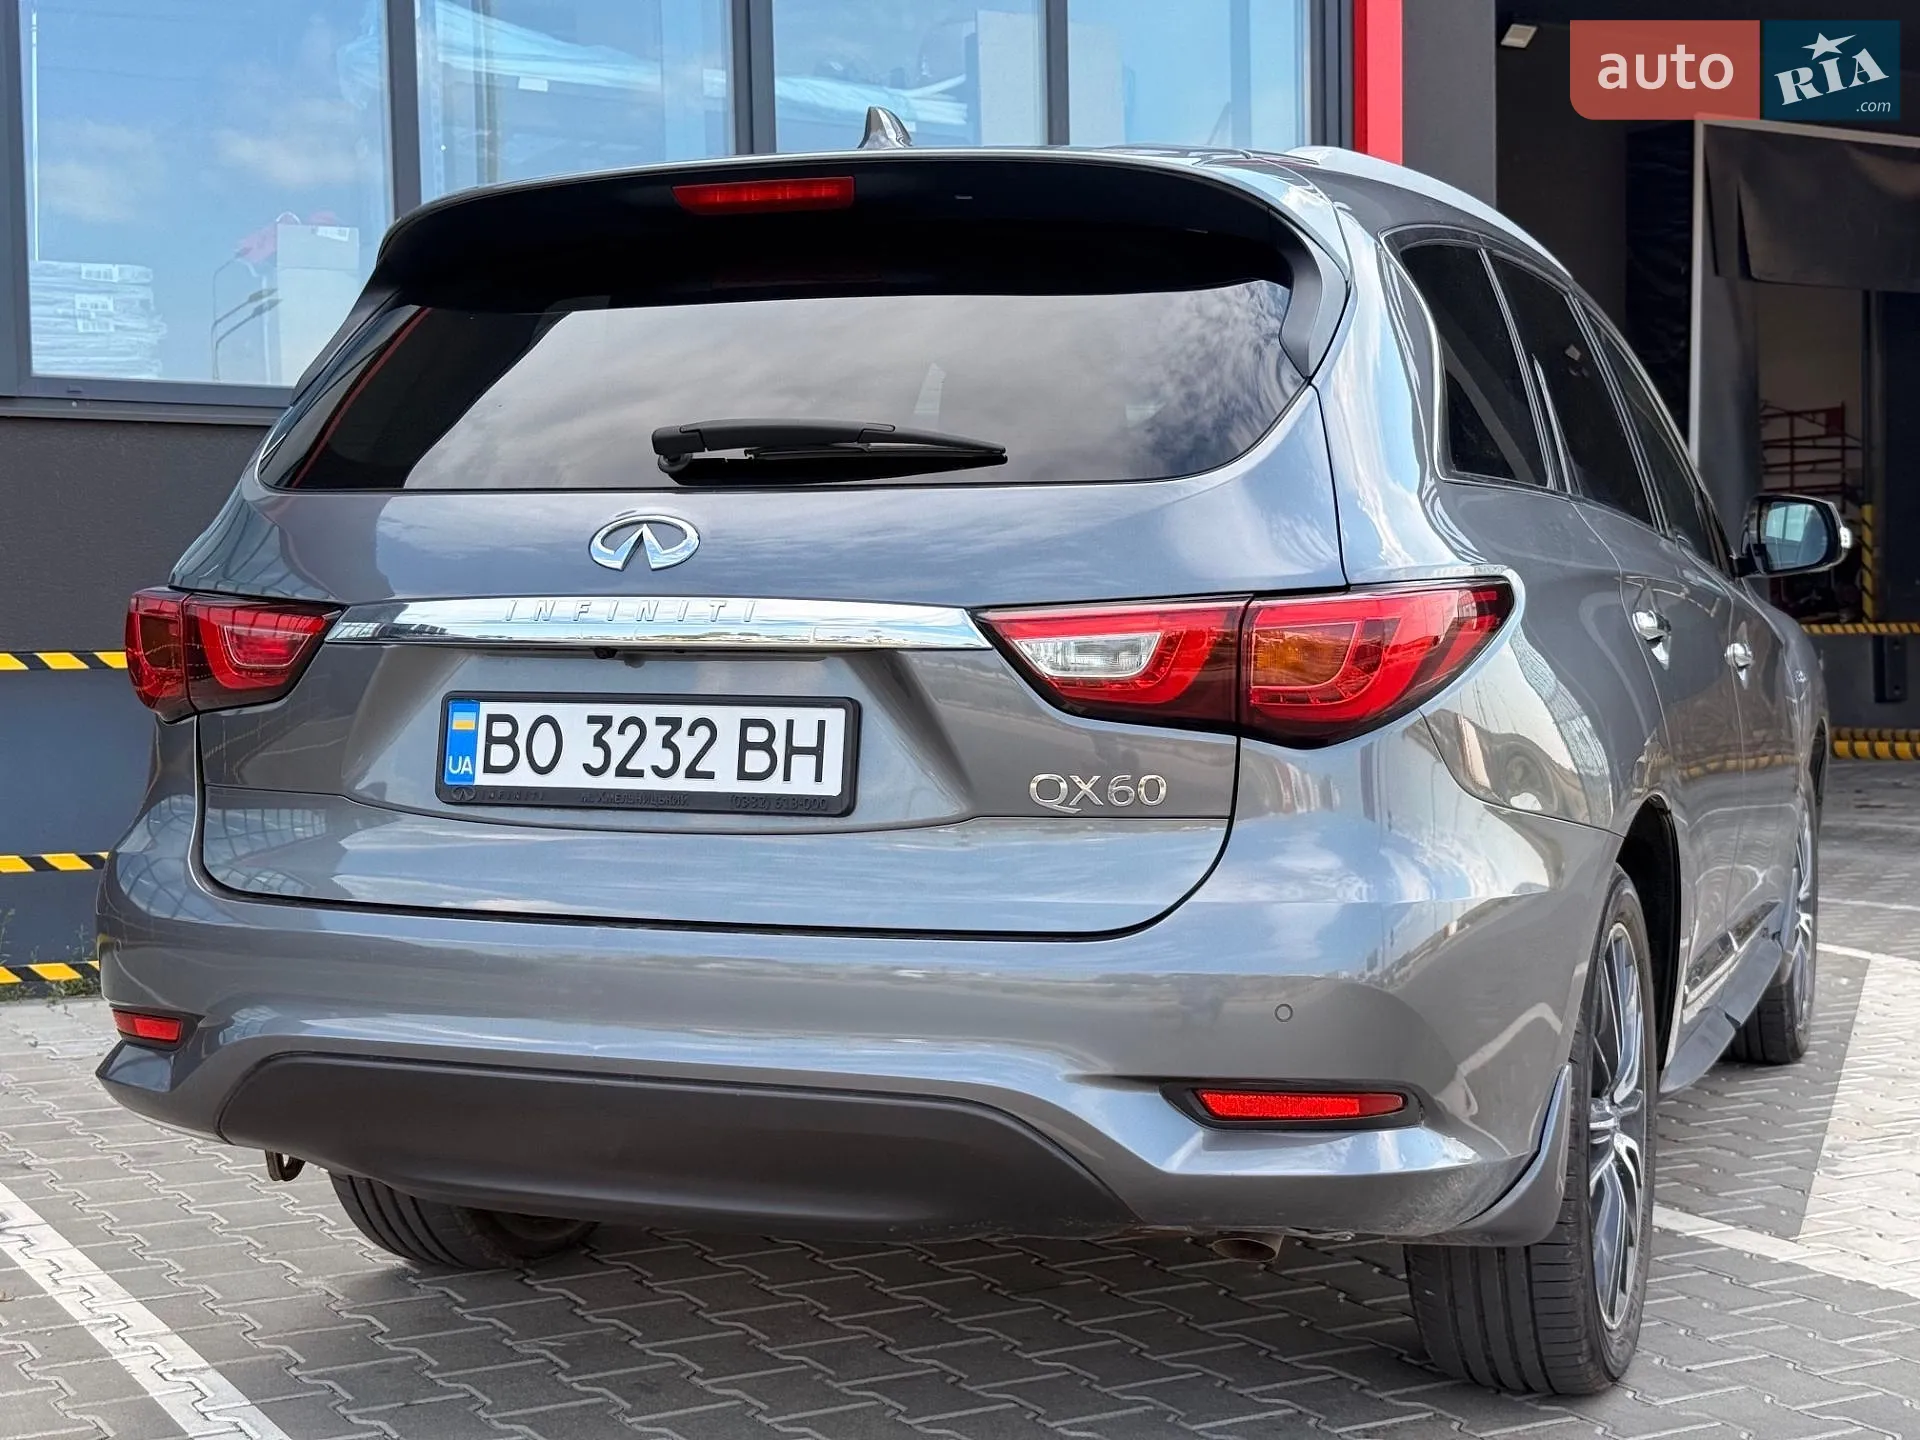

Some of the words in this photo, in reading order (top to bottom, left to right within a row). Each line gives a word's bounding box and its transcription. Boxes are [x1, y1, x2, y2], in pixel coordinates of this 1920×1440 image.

[505, 600, 759, 623] INFINITI
[483, 714, 563, 775] BO
[582, 715, 719, 780] 3232
[736, 718, 827, 783] BH
[448, 756, 474, 775] UA
[1029, 773, 1167, 814] QX60
